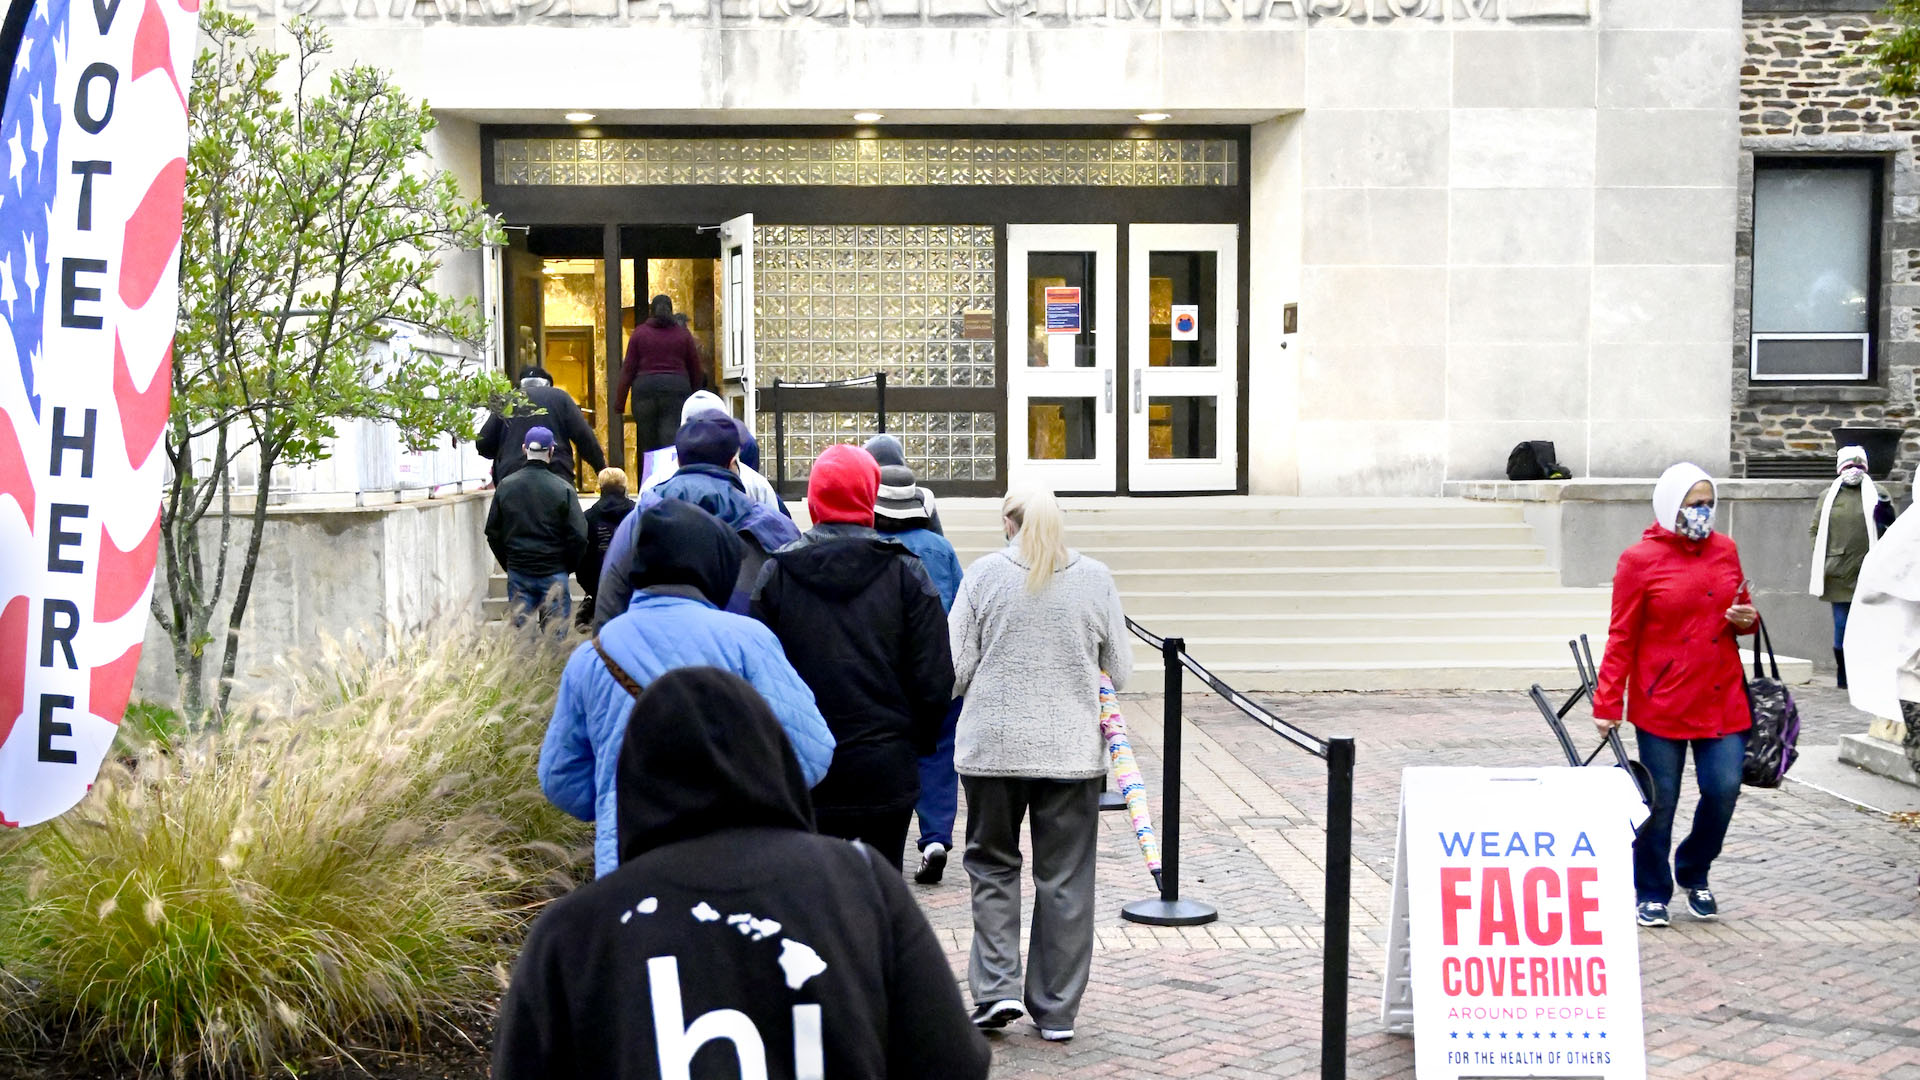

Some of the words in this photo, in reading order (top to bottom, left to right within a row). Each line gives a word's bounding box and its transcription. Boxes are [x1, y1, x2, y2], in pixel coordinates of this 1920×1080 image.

[38, 407, 98, 764] HERE
[1438, 831, 1556, 857] WEAR
[1570, 831, 1596, 857] A
[1440, 866, 1603, 946] FACE
[1442, 956, 1607, 997] COVERING
[1448, 1007, 1528, 1020] AROUND
[1535, 1007, 1607, 1020] PEOPLE
[1448, 1051, 1470, 1065] FOR
[1474, 1051, 1495, 1065] THE
[1500, 1051, 1543, 1065] HEALTH
[1548, 1051, 1561, 1065] OF
[1567, 1051, 1611, 1065] OTHERS
